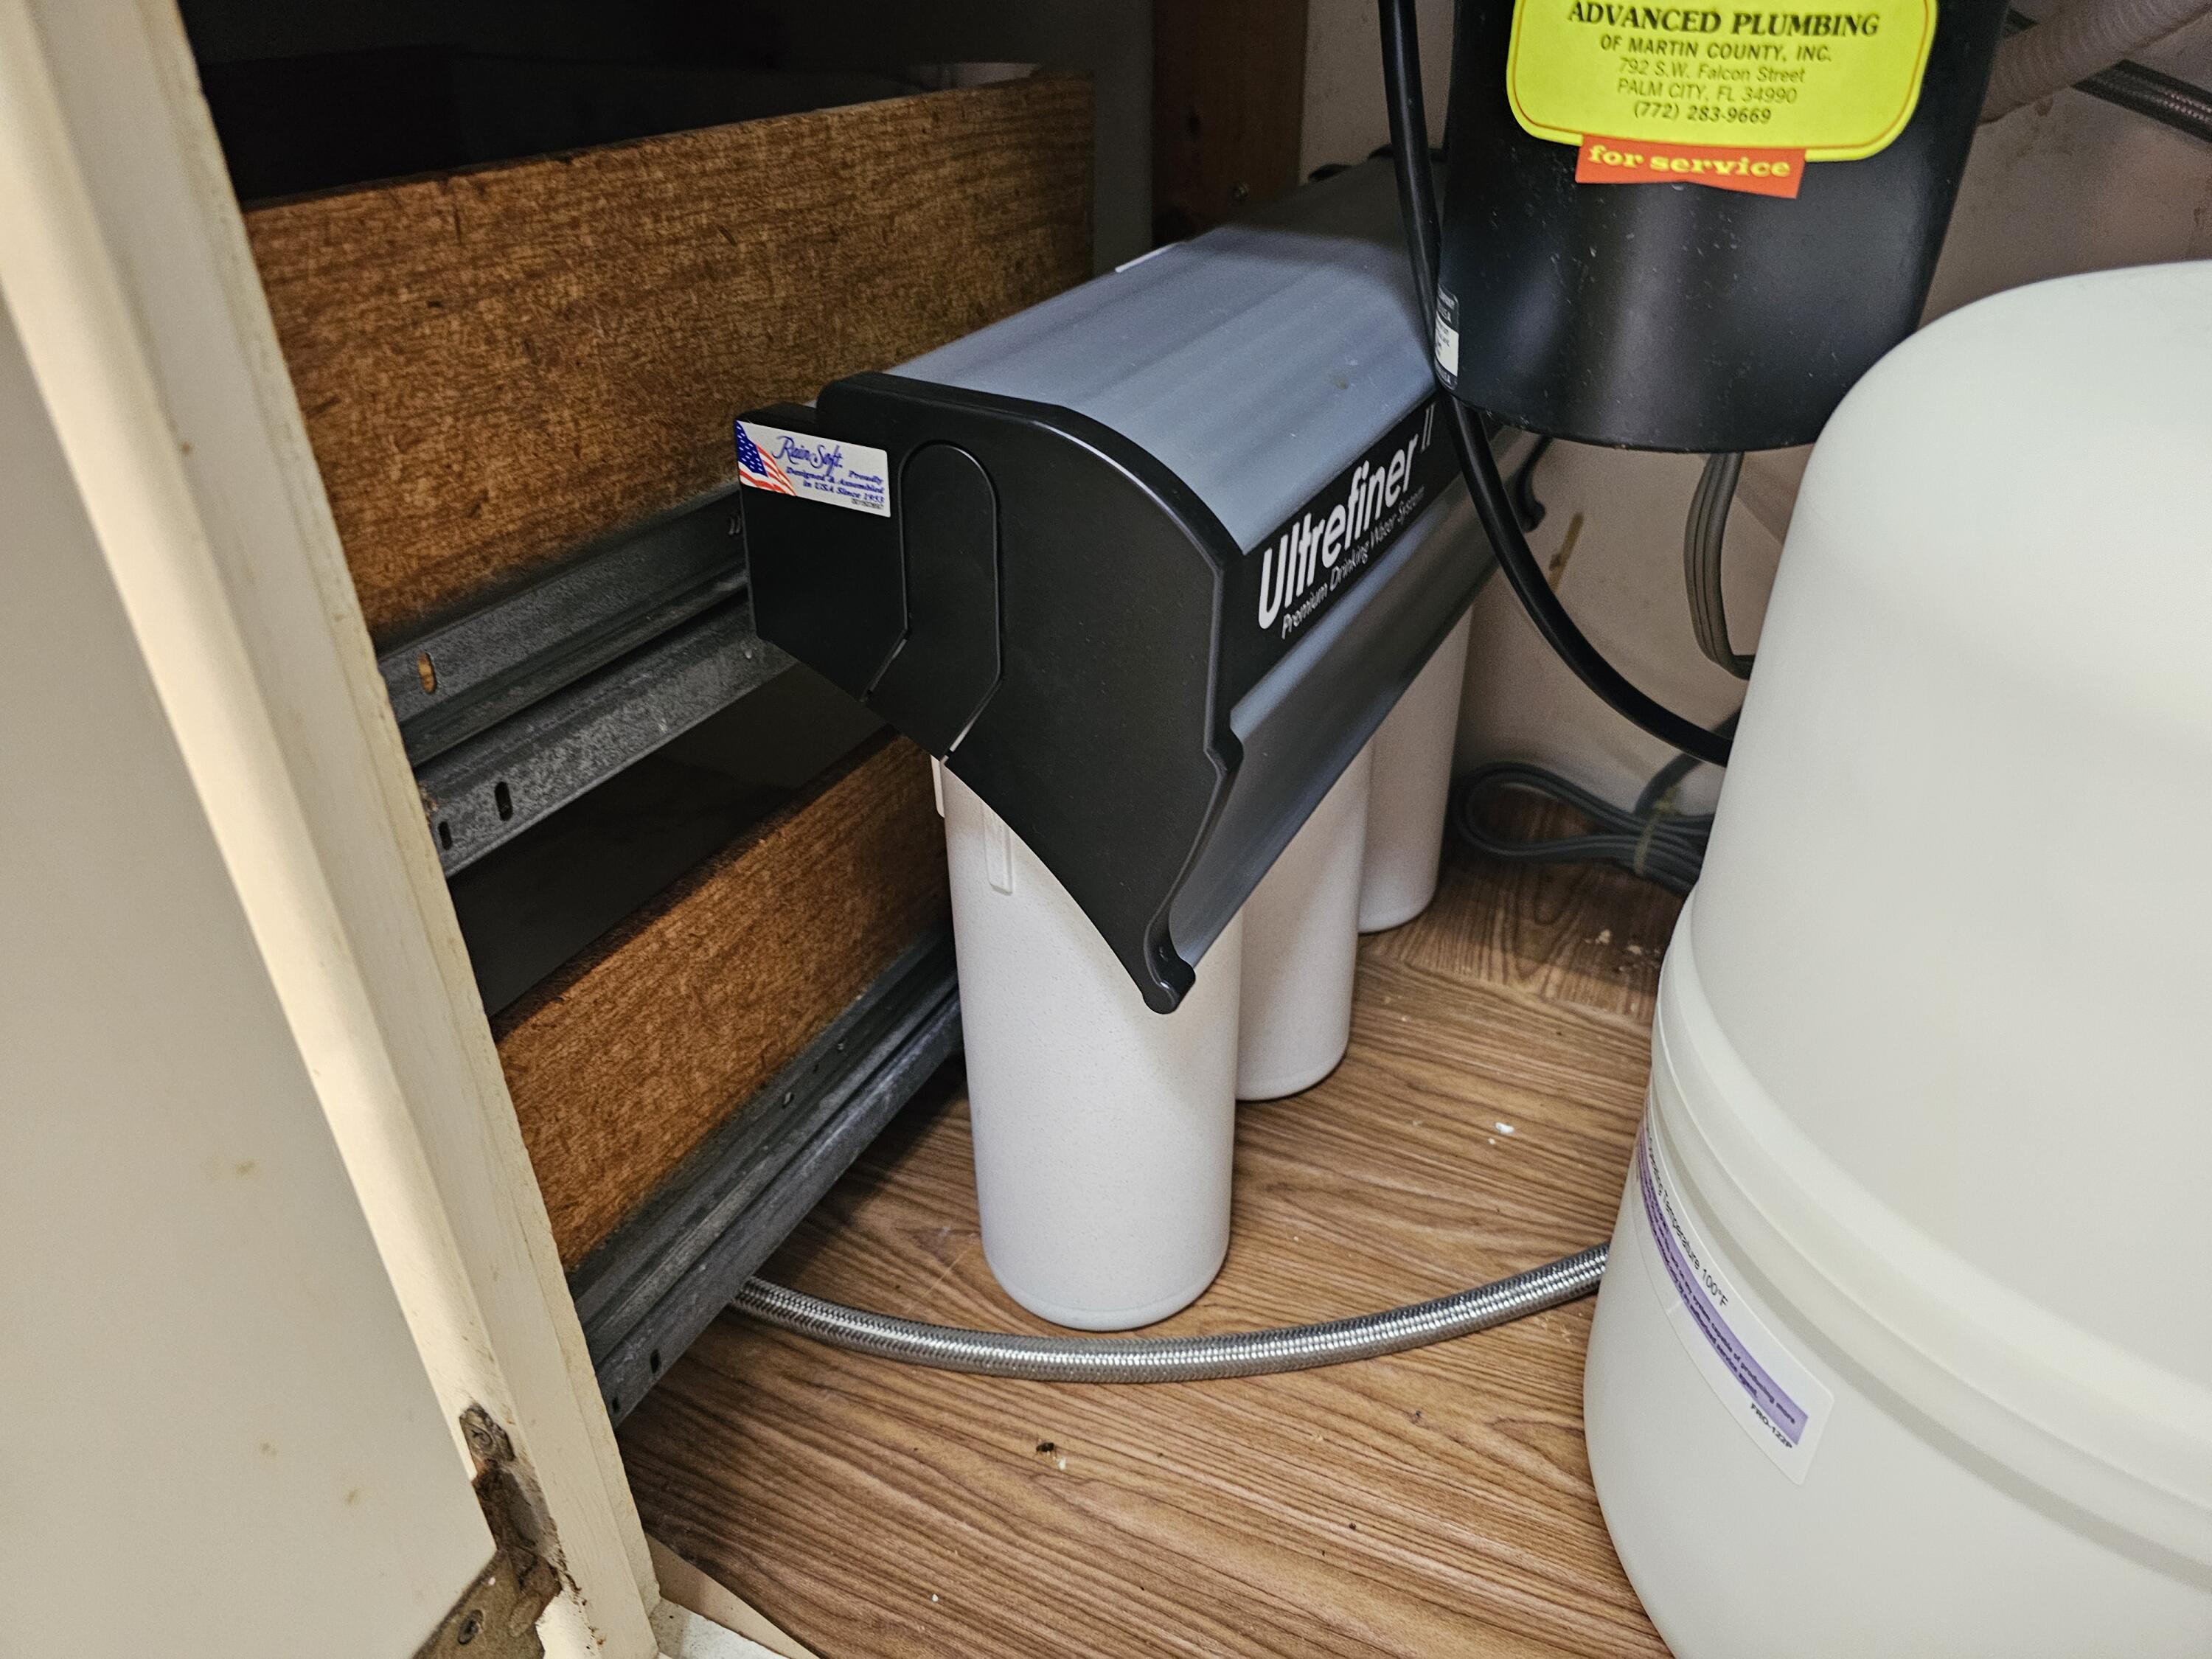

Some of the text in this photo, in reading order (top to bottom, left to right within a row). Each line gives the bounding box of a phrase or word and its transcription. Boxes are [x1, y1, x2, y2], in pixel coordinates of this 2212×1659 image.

[1568, 0, 1879, 37] ADVANCED PLUMBING
[1600, 34, 1623, 51] OF
[1628, 37, 1698, 58] MARTIN
[1796, 45, 1832, 63] INC.
[1619, 56, 1806, 83] 792 S.W. Falcon Street
[1618, 77, 1663, 97] PALM
[1717, 86, 1735, 102] FL
[1741, 86, 1798, 104] 34990
[1634, 100, 1772, 124] (772) 283-9669
[1588, 145, 1790, 178] for service
[786, 466, 826, 481] Designed
[839, 479, 885, 494] Assembled
[815, 481, 835, 493] USA
[836, 487, 861, 499] Since
[848, 470, 883, 485] Proudly
[1258, 433, 1419, 630] Ultrefiner
[1281, 484, 1425, 640] Premium Drinking Water System
[1663, 1189, 1729, 1307] Temperature 100°F
[1711, 1323, 1733, 1353] capable
[1740, 1362, 1775, 1404] producing
[1776, 1402, 1795, 1425] more
